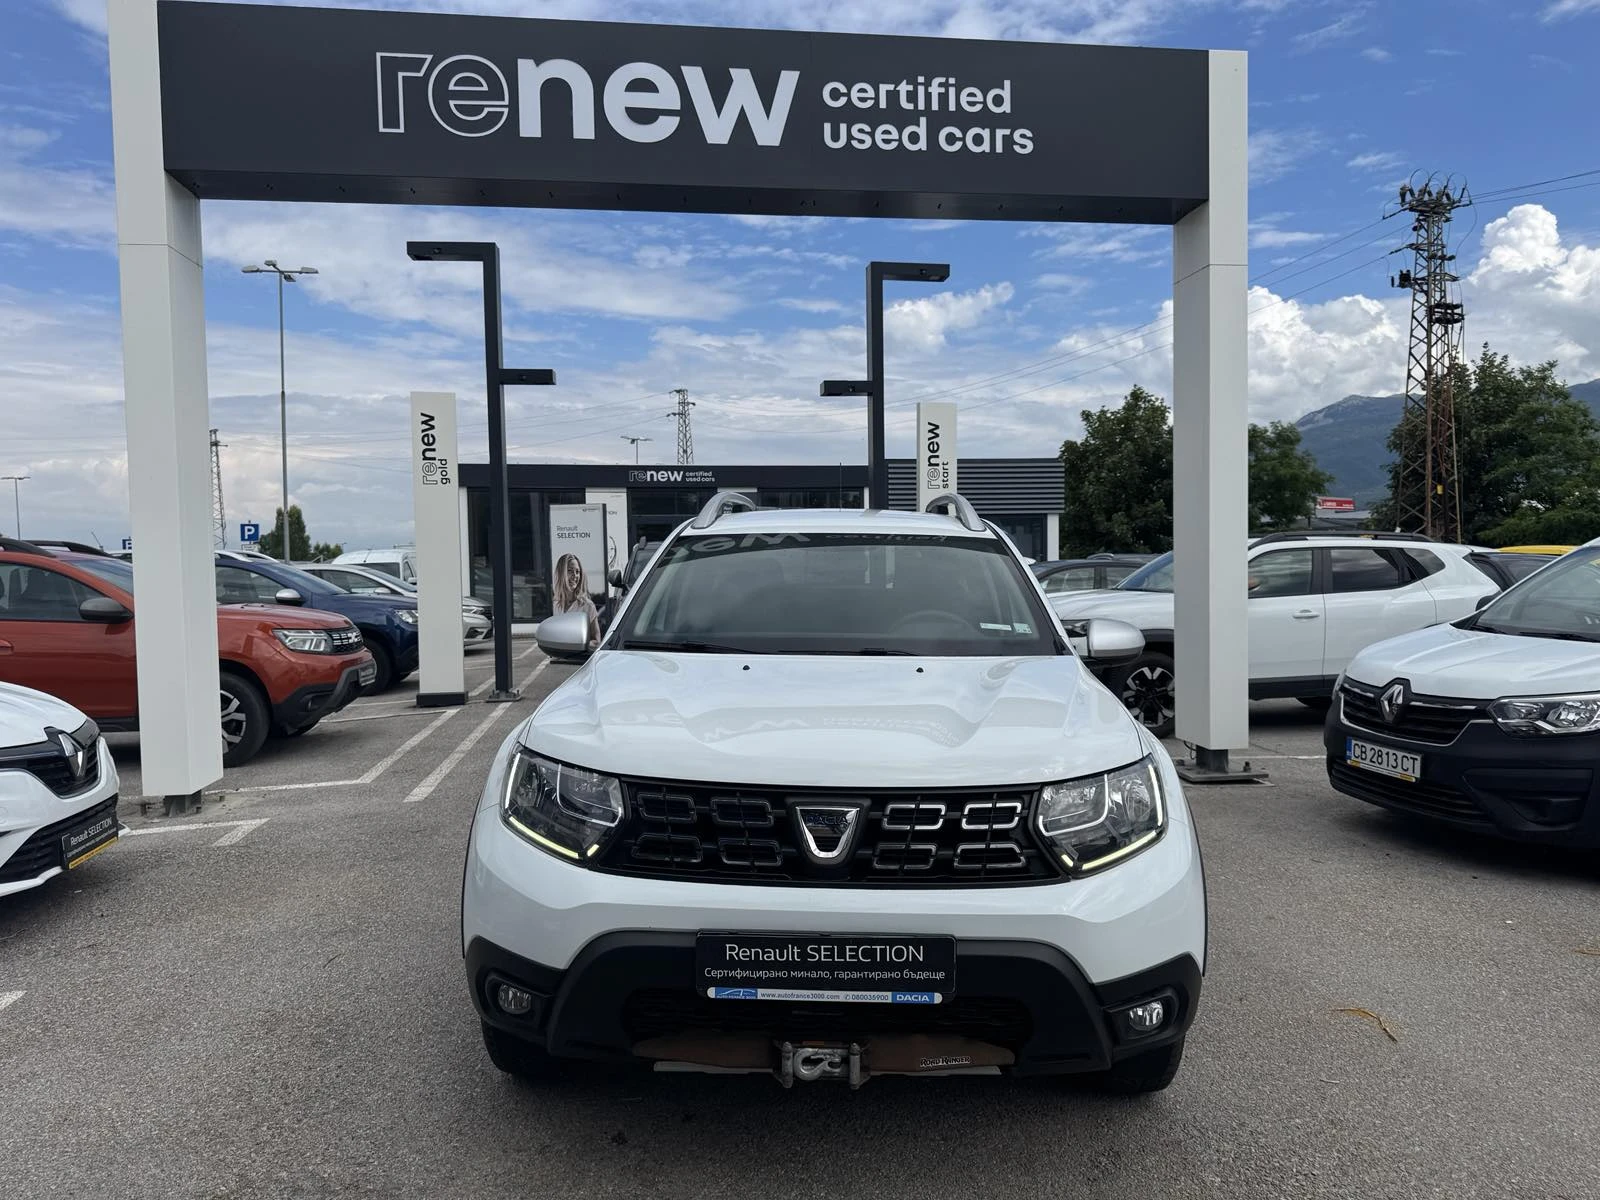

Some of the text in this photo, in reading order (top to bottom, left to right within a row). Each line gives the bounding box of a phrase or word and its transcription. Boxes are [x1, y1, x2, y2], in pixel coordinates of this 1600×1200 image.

[376, 52, 801, 147] renew
[822, 75, 1012, 114] certified
[823, 116, 1035, 155] used cars
[420, 412, 438, 485] renew
[927, 421, 940, 490] renew
[438, 458, 451, 485] gold
[628, 470, 684, 482] renew
[244, 525, 255, 540] P
[1369, 747, 1399, 769] 2813
[71, 830, 88, 847] Renault
[88, 817, 112, 837] SELECTION
[725, 944, 924, 962] Renault SELECTION
[704, 967, 946, 981] Сертифицирано минало, гарантирано бъдеще
[896, 994, 930, 1002] DACIA
